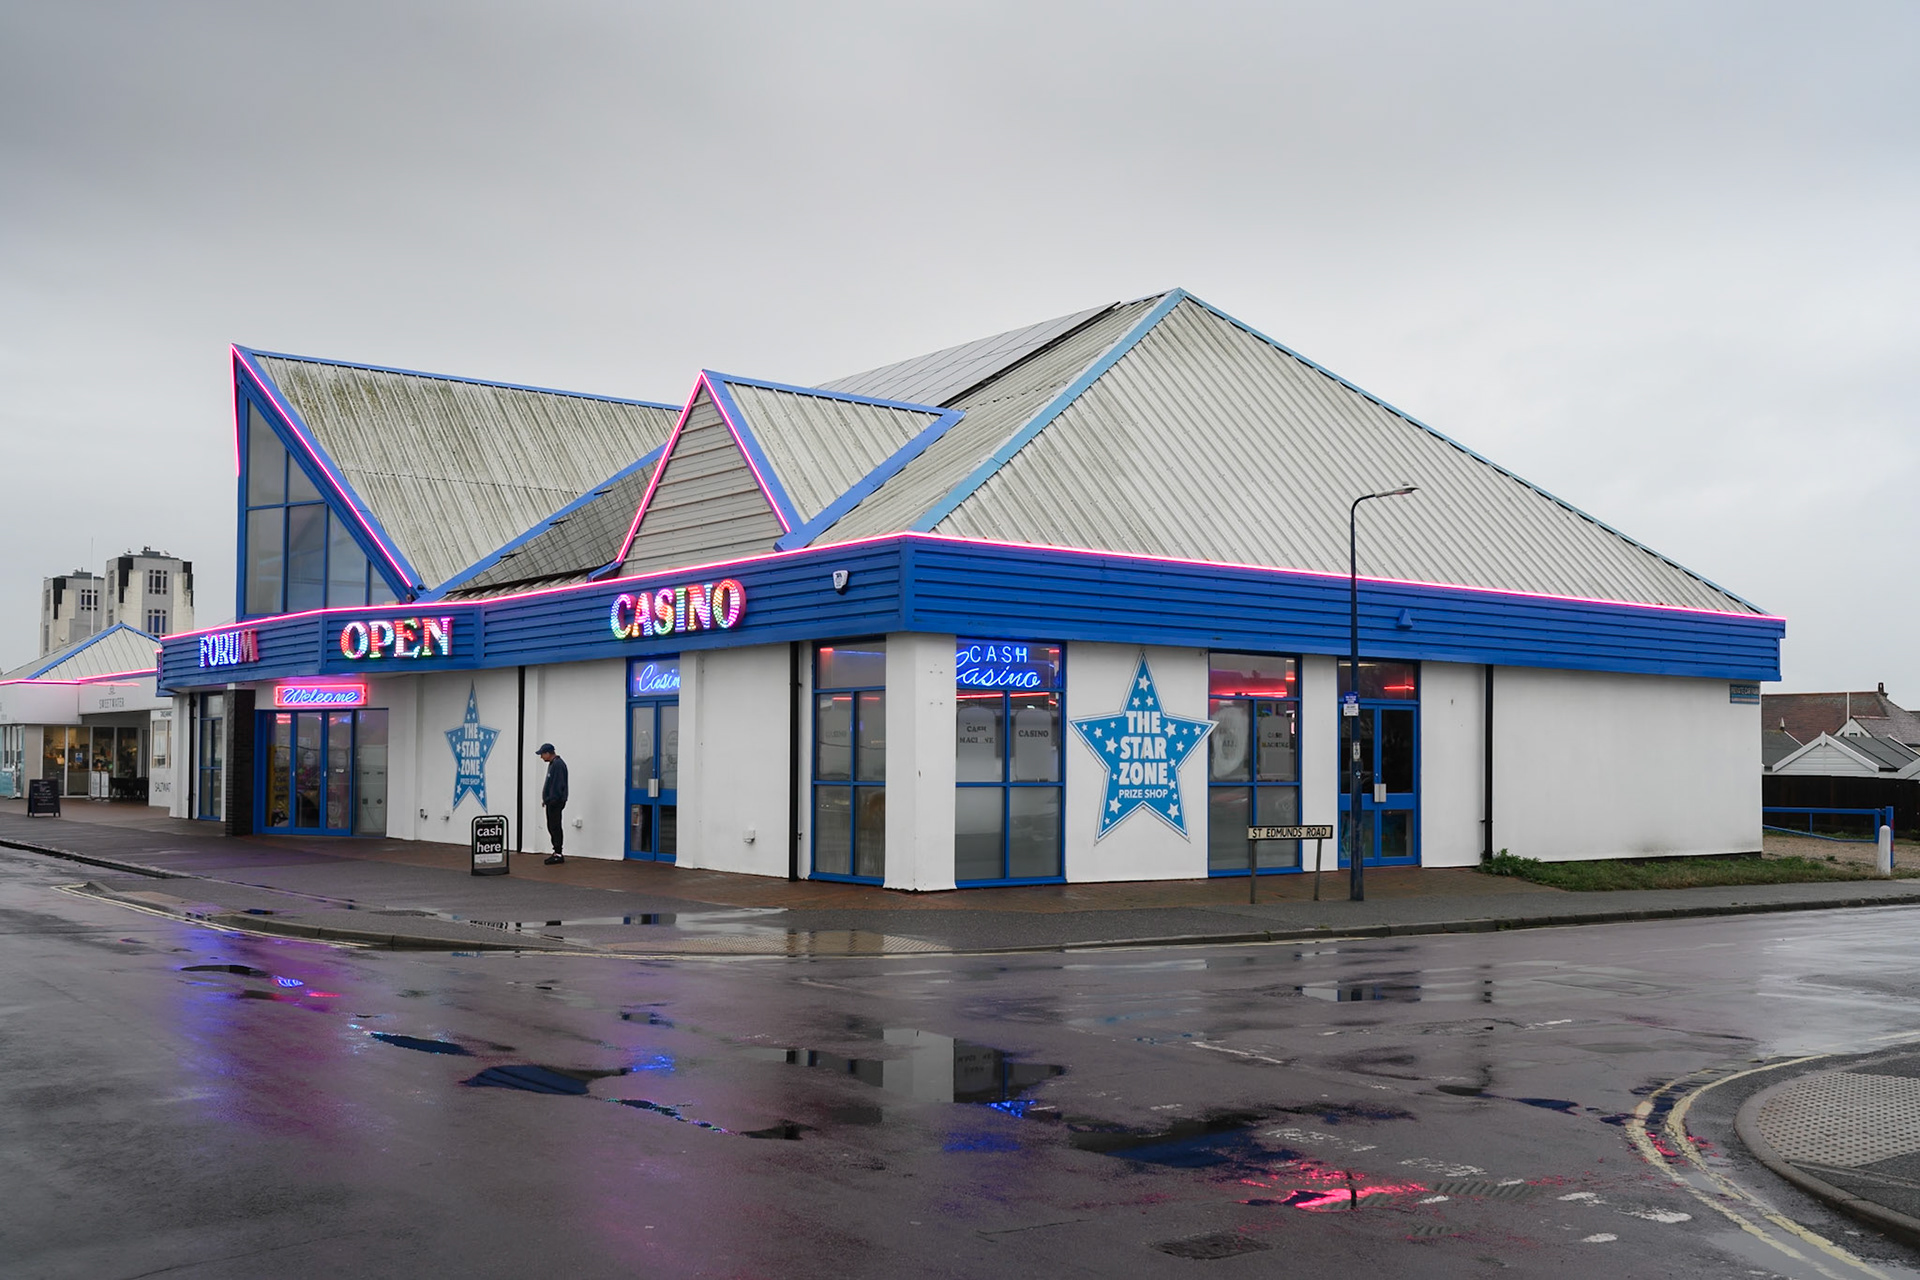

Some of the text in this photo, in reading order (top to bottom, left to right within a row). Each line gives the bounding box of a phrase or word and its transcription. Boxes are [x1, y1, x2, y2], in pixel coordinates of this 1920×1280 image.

[611, 579, 744, 638] CASINO
[341, 617, 452, 658] OPEN
[199, 630, 257, 667] FORUM
[970, 646, 1027, 662] CASH
[283, 689, 357, 703] Welcome
[1126, 711, 1161, 733] THE
[464, 723, 478, 739] THE
[461, 741, 480, 758] STAR
[1120, 736, 1167, 759] STAR
[461, 759, 480, 776] ZONE
[1119, 762, 1167, 785] ZONE
[1119, 789, 1168, 798] PRIZE SHOP
[477, 825, 502, 837] cash
[1252, 827, 1327, 838] ST EDMUNDS ROAD
[476, 841, 501, 853] here
